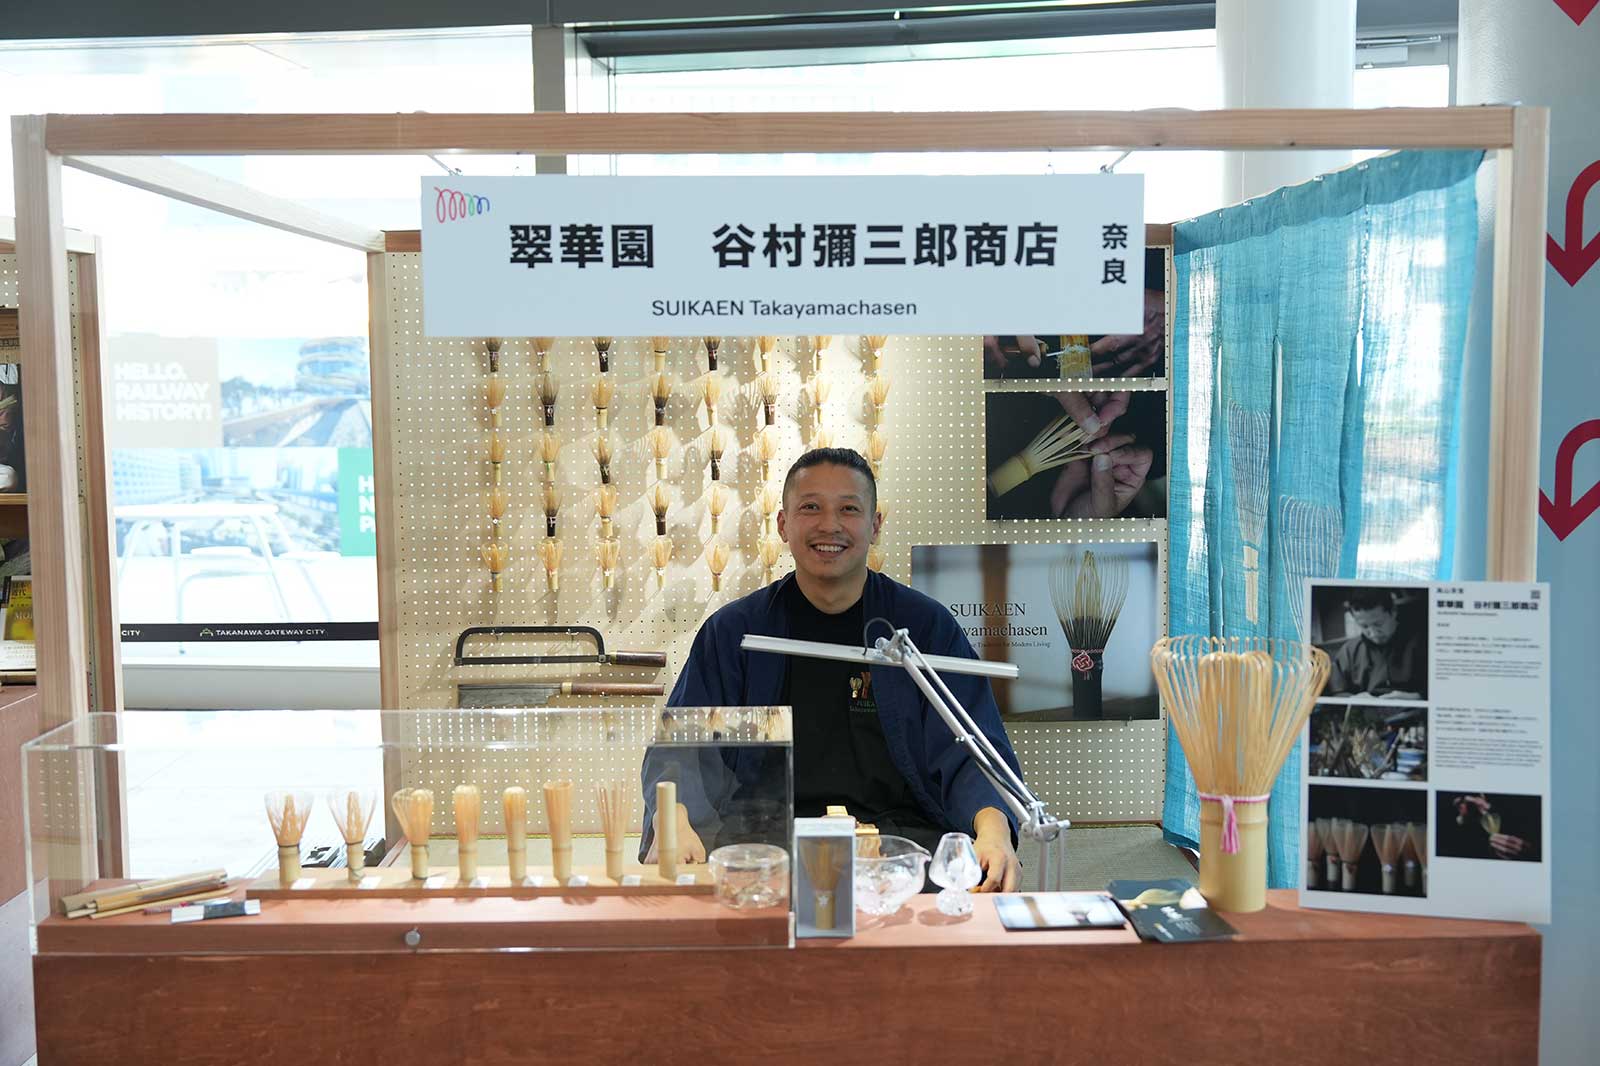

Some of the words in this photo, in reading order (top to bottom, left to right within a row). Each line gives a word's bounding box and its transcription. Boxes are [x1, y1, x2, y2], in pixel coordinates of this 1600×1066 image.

[509, 223, 654, 269] 翠華園
[711, 222, 1058, 269] 谷村彌三郎商店
[1101, 223, 1128, 285] 奈良
[652, 300, 744, 316] SUIKAEN
[749, 300, 917, 319] Takayamachasen
[115, 382, 209, 400] RAILWAY
[950, 603, 1026, 617] SUIKAEN
